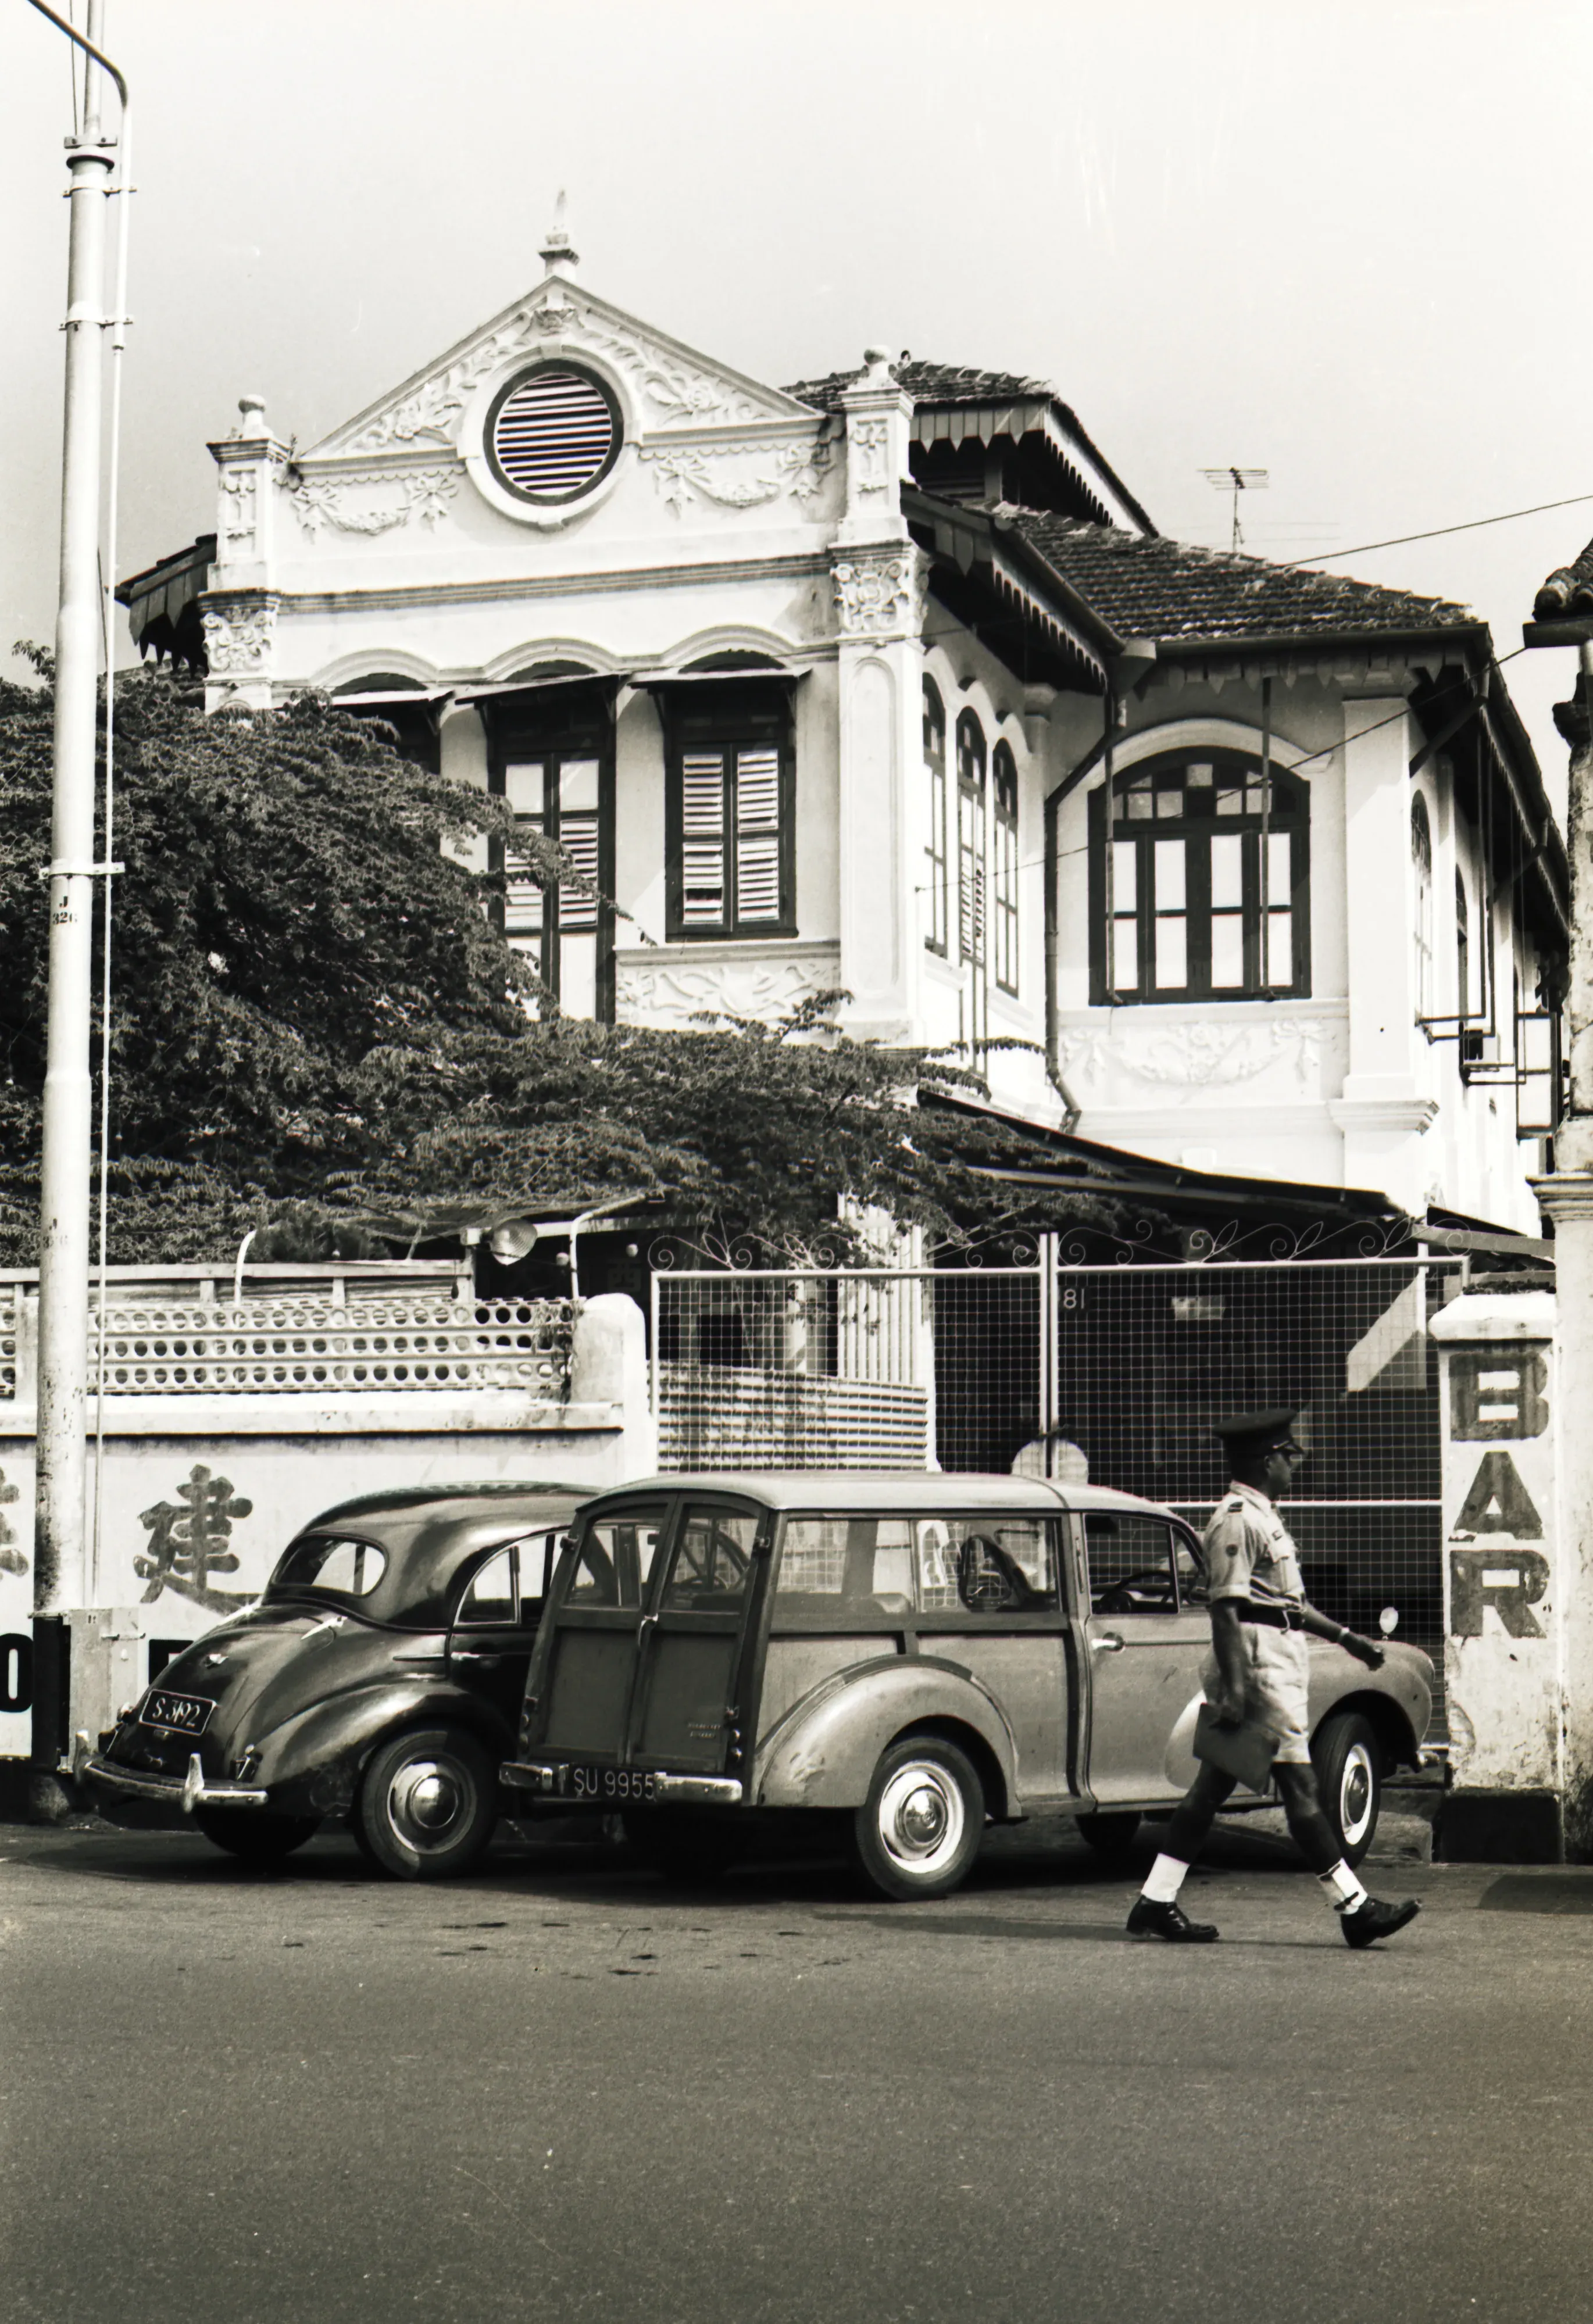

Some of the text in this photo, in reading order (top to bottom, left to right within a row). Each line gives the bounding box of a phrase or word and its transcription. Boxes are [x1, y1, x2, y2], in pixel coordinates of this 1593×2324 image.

[59, 896, 68, 908] J
[1063, 1288, 1085, 1309] 81
[1448, 1352, 1550, 1639] BAR
[152, 1697, 166, 1718] S
[573, 1768, 655, 1800] SU 9955
